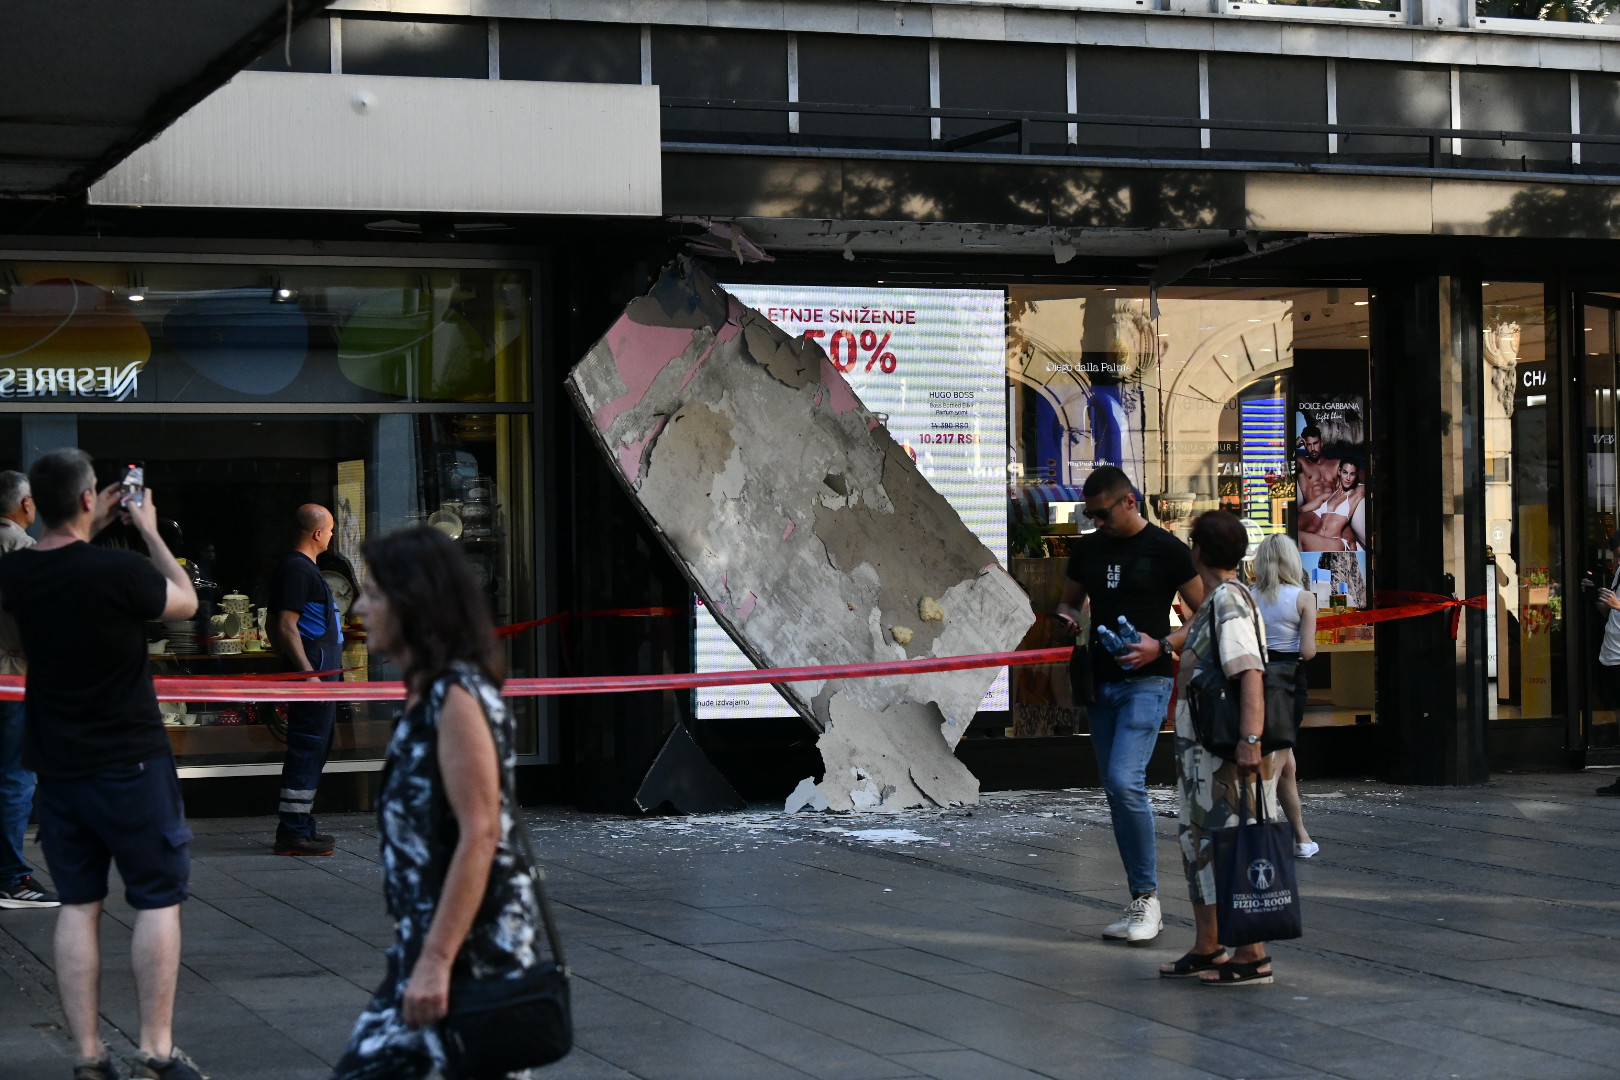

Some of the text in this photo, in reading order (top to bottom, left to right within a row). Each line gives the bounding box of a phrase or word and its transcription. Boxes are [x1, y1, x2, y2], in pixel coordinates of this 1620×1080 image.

[757, 306, 916, 325] ETNJE SNIŽENJE
[1046, 362, 1132, 373] Diego dalla Palma
[929, 391, 975, 399] HUGO BOSS
[1315, 412, 1330, 423] light
[919, 433, 981, 444] 10.217 RSD
[715, 698, 750, 707] izdvajamo
[1233, 896, 1292, 908] FIZIO-ROOM
